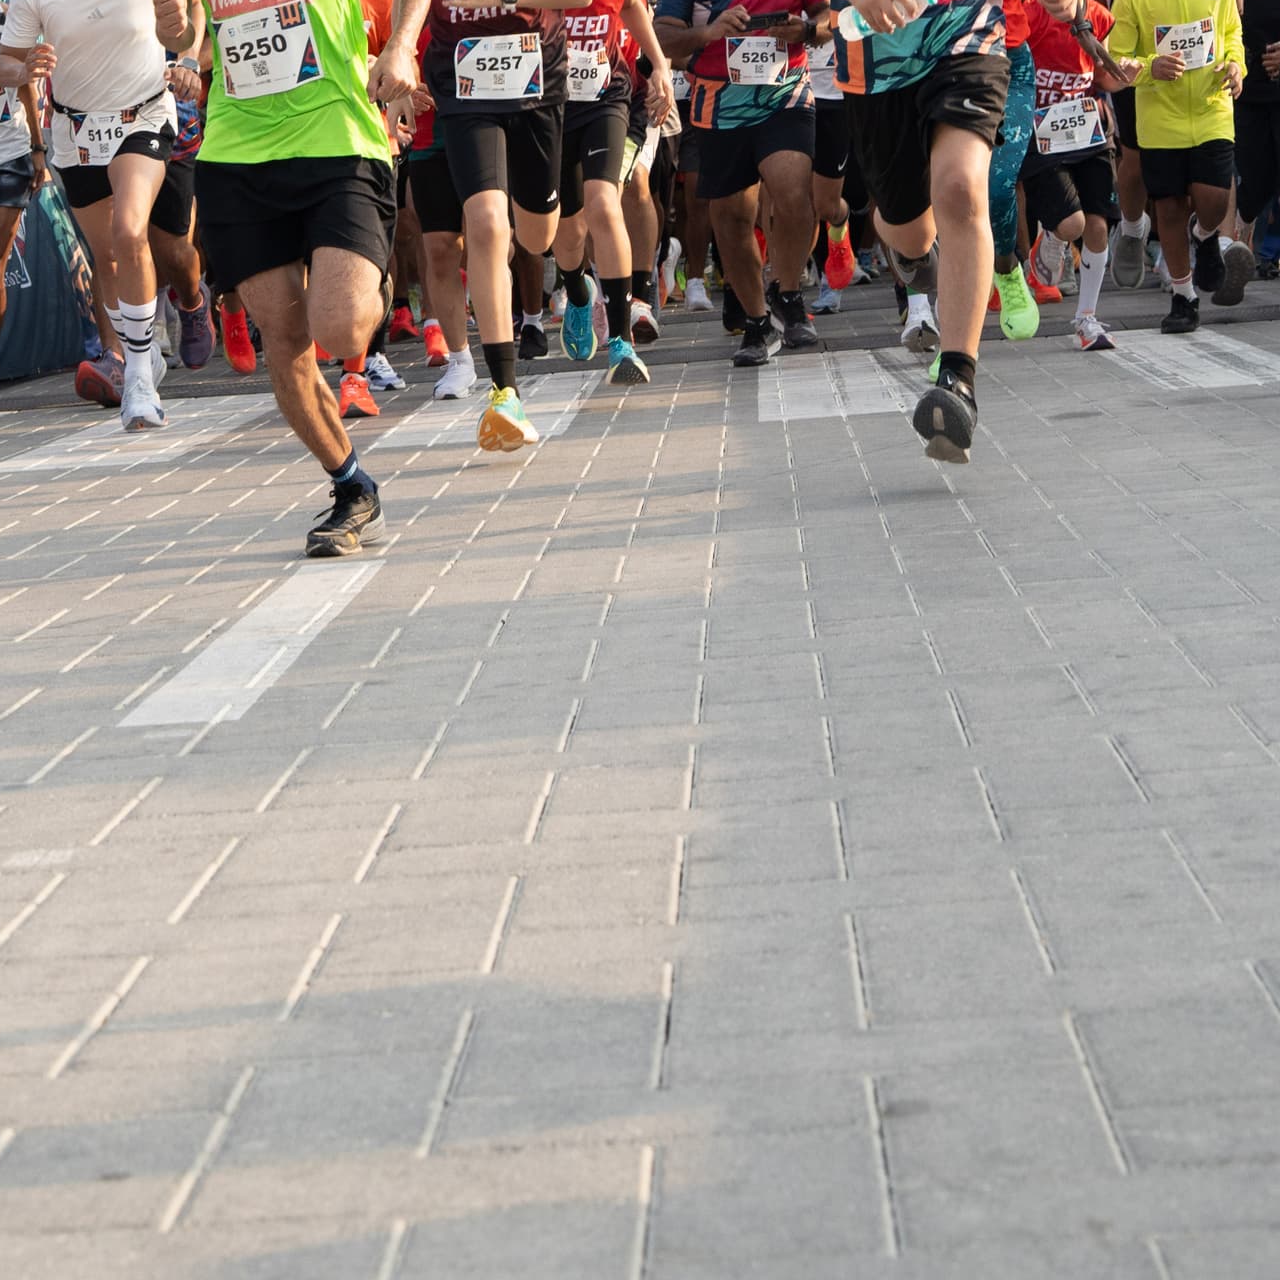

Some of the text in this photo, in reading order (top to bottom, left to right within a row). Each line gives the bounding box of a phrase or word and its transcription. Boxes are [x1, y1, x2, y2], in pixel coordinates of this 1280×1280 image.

[225, 33, 288, 64] 5250
[1170, 35, 1204, 51] 5254
[475, 55, 523, 72] 5257
[741, 52, 777, 63] 5261
[570, 67, 598, 79] 208
[1050, 115, 1086, 132] 5255
[88, 127, 123, 142] 5116
